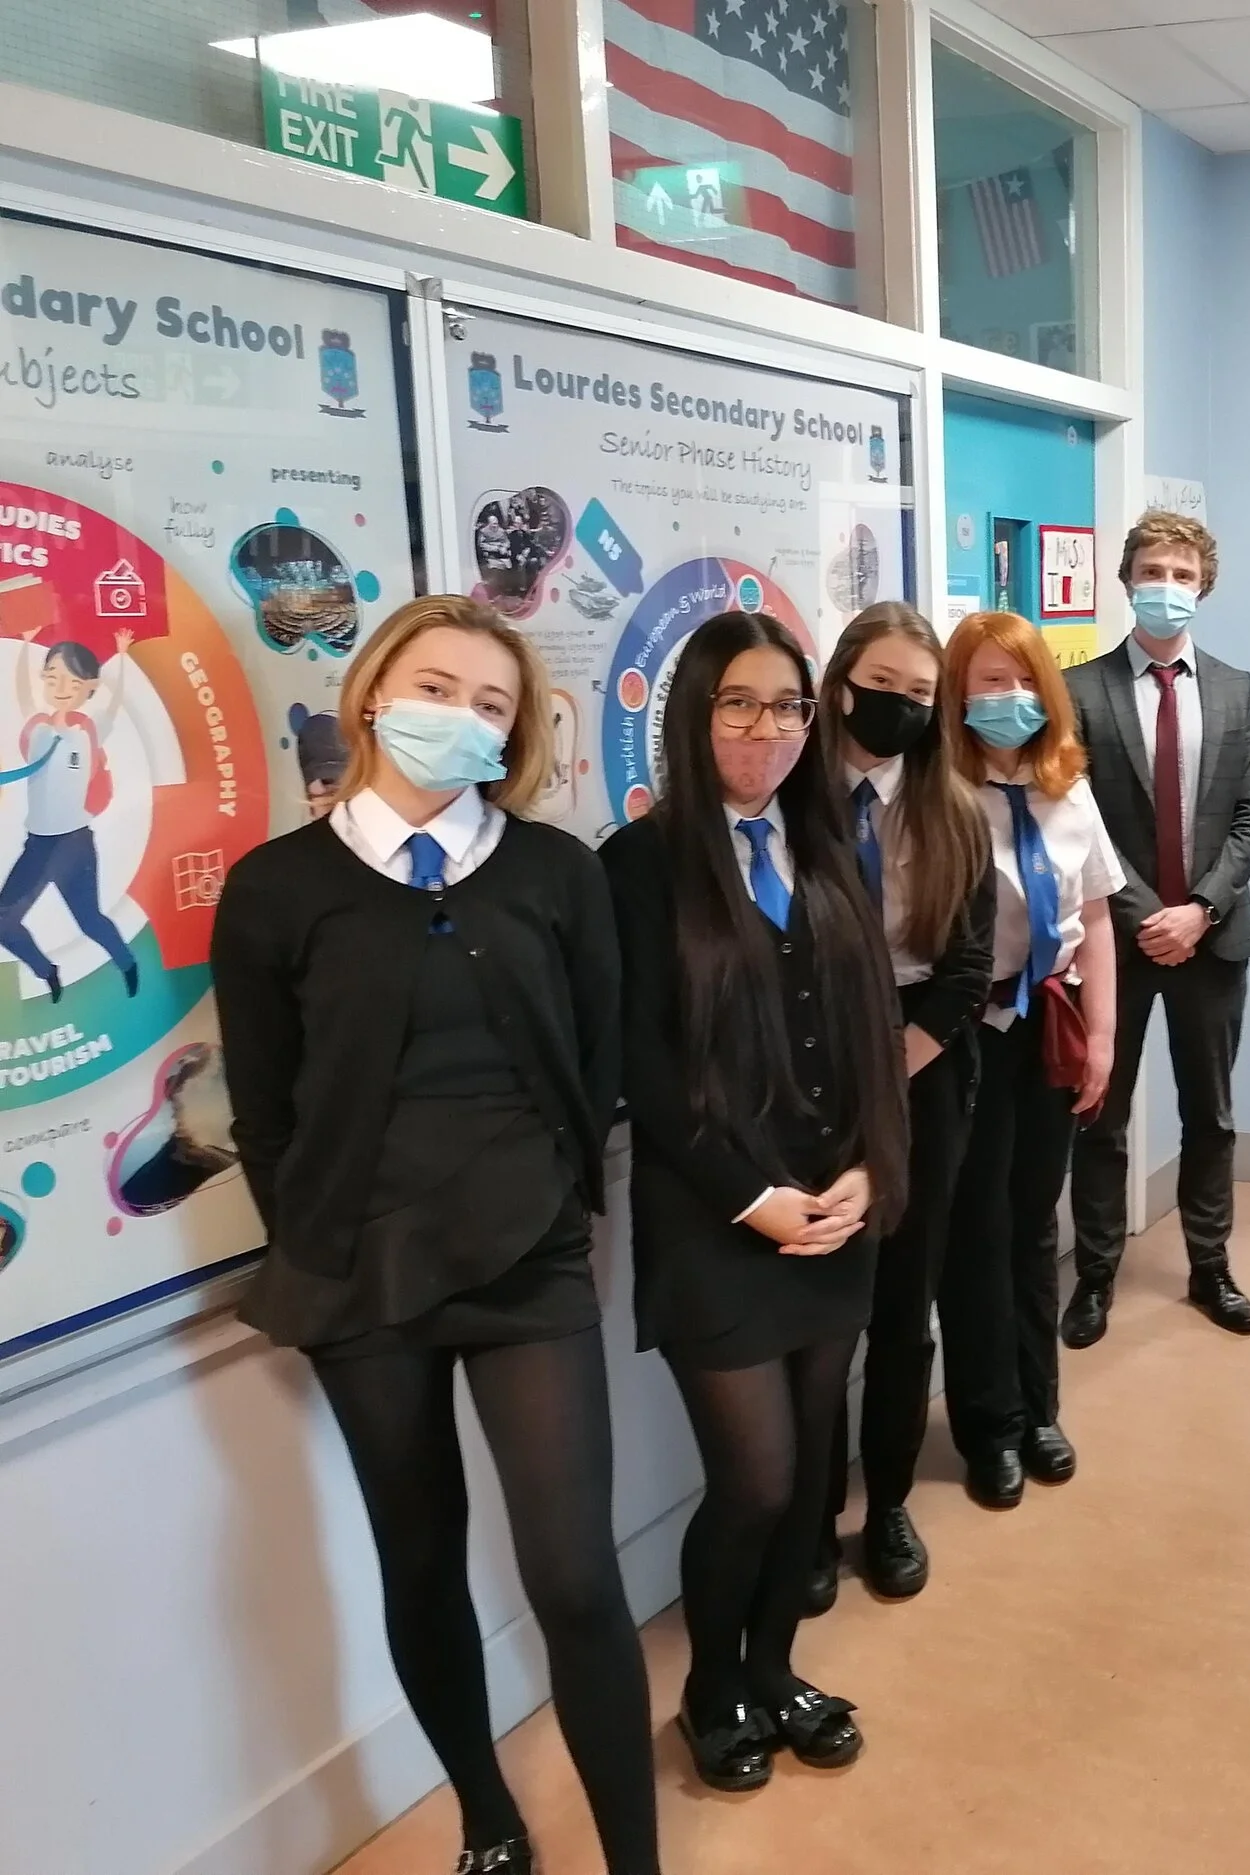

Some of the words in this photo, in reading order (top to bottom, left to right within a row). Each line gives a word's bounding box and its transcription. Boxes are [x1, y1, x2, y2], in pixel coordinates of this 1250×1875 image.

[277, 71, 358, 120] FIRE
[279, 108, 359, 168] EXIT
[1, 274, 138, 346] dary
[155, 295, 305, 360] School
[513, 354, 642, 410] Lourdes
[650, 381, 786, 442] Secondary
[793, 408, 864, 446] School
[45, 450, 134, 480] analyse
[270, 466, 362, 491] presenting
[599, 428, 674, 462] Senior
[677, 439, 736, 471] Phase
[742, 446, 812, 492] History
[169, 496, 208, 515] how
[610, 479, 633, 495] The
[634, 480, 668, 502] topics
[671, 486, 694, 506] you
[697, 484, 719, 503] ill
[720, 489, 733, 504] be
[734, 491, 787, 514] studying
[162, 517, 216, 549] fully
[688, 583, 727, 605] World
[180, 651, 237, 818] GEOGRAPHY
[0, 1033, 114, 1090] TOURISM
[2, 1117, 93, 1152] compare
